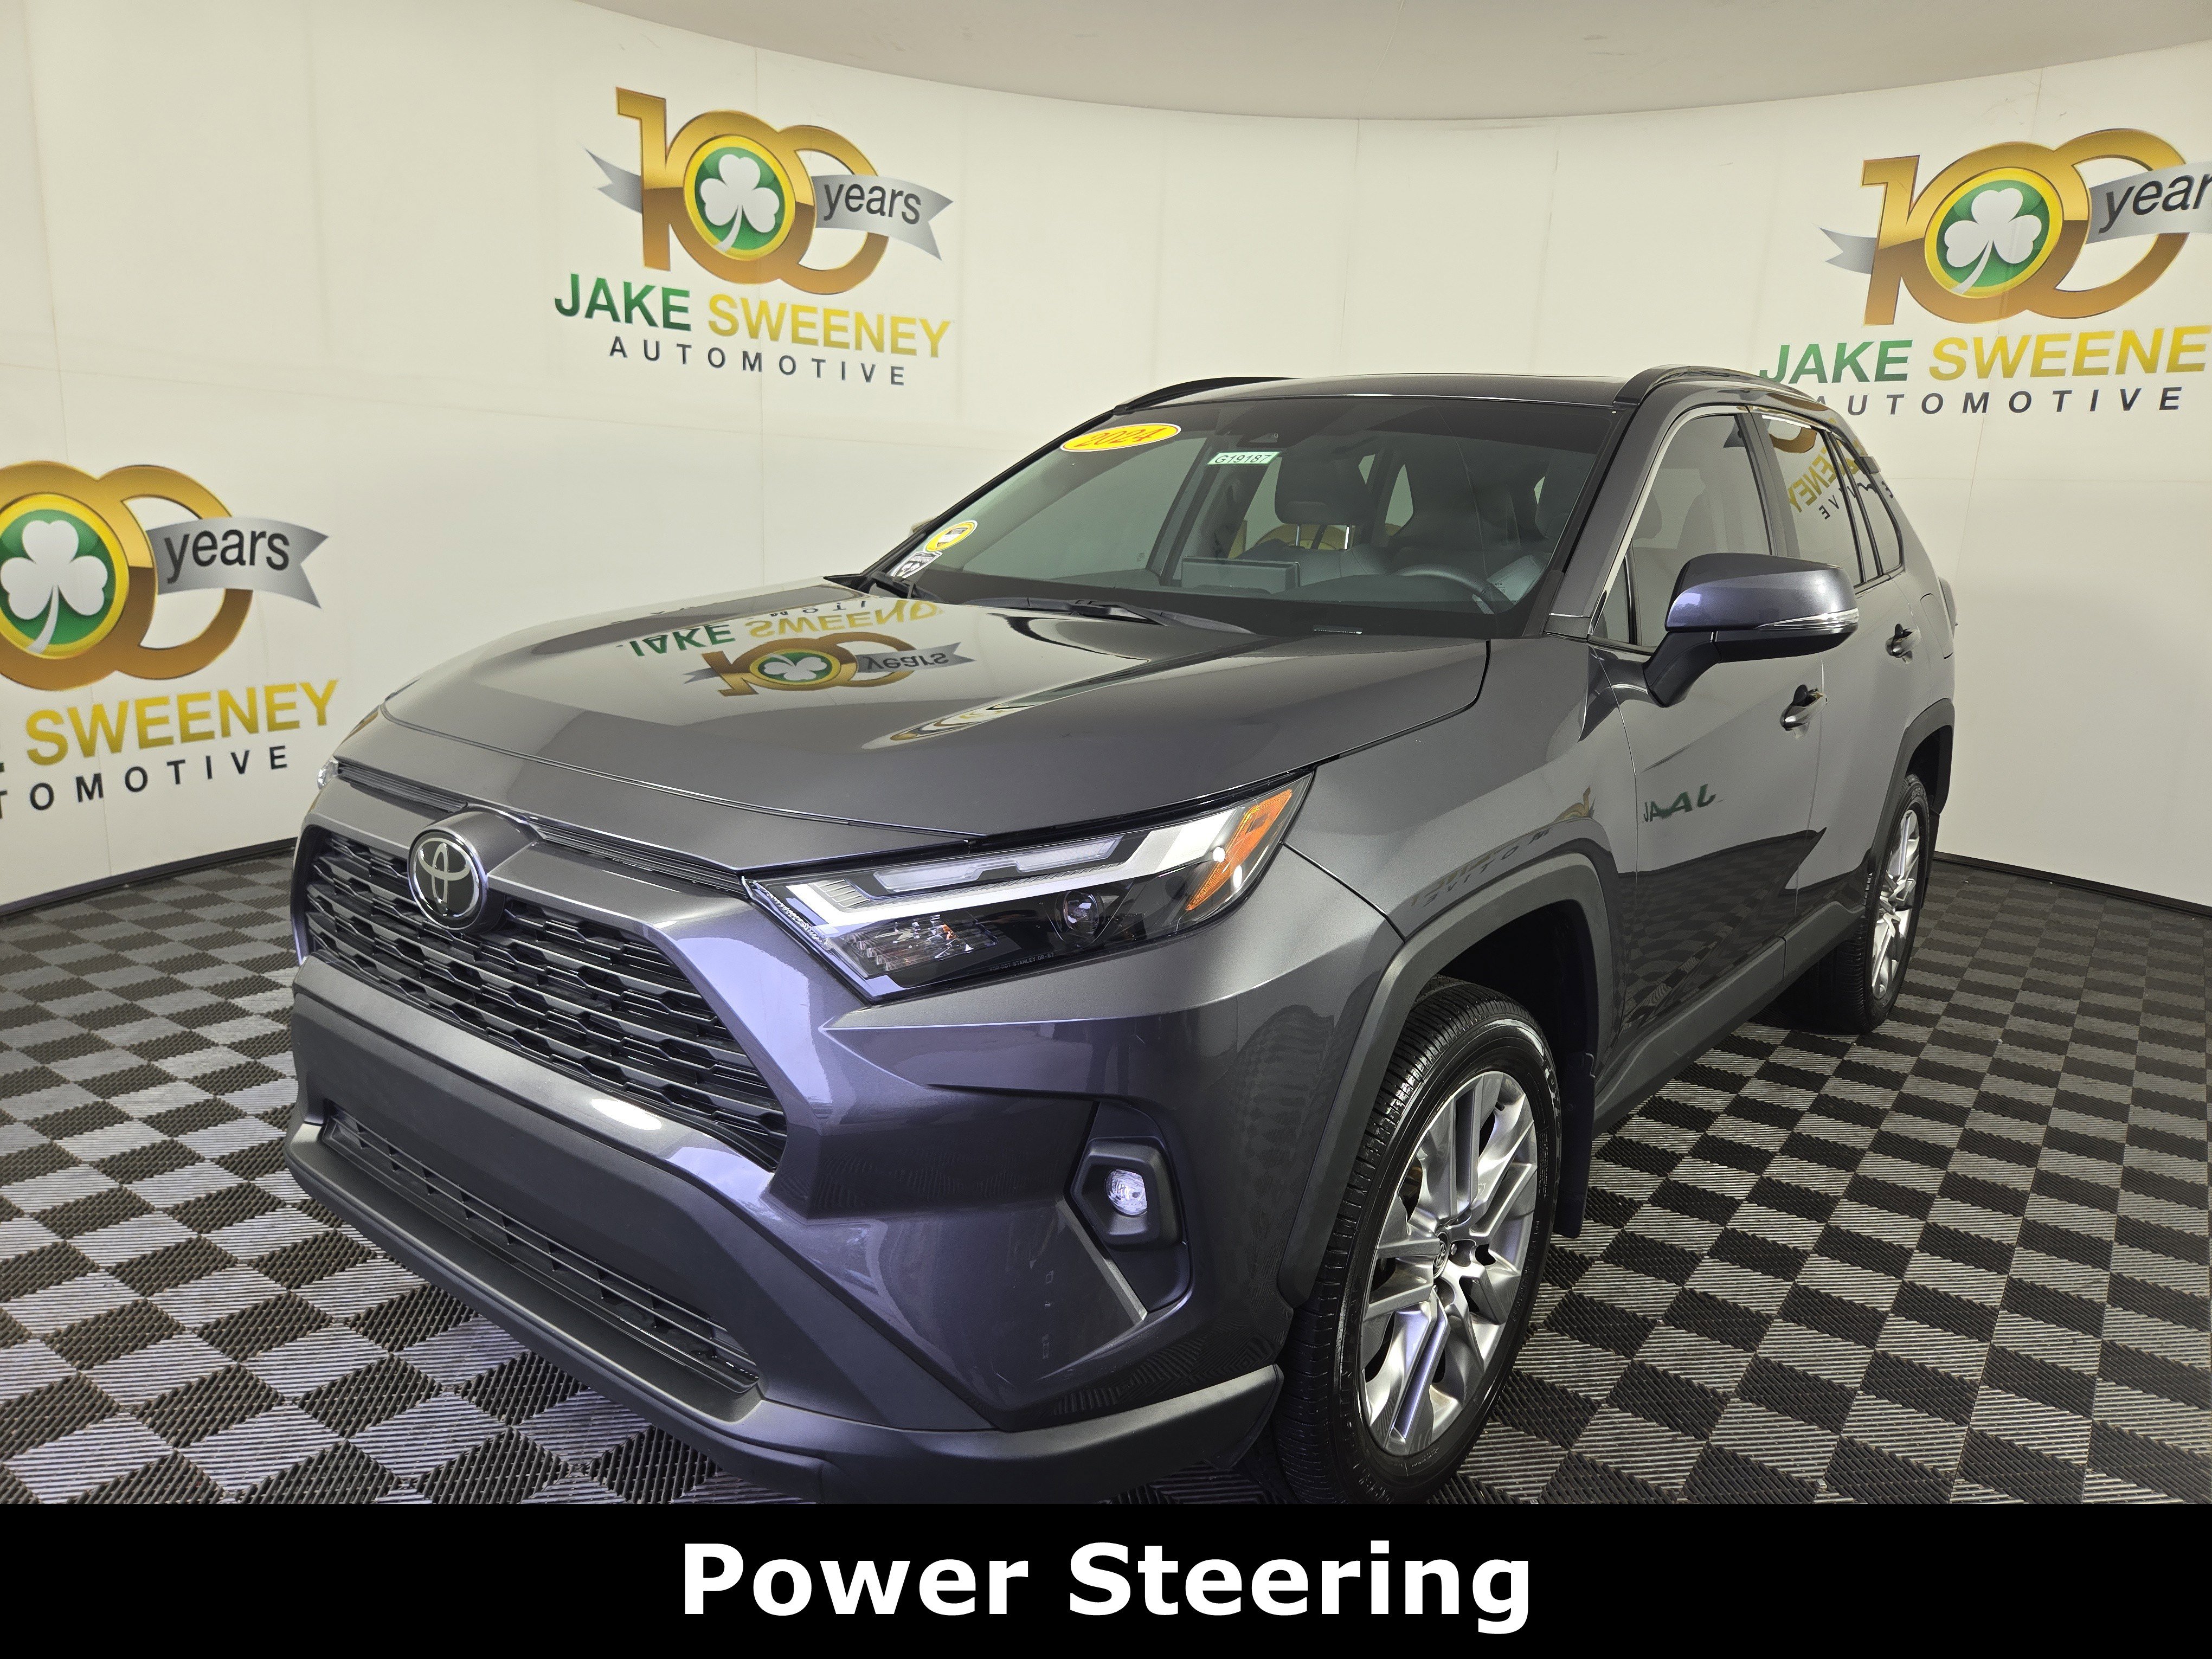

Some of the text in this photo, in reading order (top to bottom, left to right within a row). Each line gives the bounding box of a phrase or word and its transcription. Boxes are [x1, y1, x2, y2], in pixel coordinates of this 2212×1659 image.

[823, 183, 922, 224] years
[555, 273, 952, 358] JAKE SWEENEY
[609, 336, 905, 386] AUTOMOTIVE
[1759, 339, 1913, 384] JAKE
[1073, 427, 1168, 448] 2024
[1214, 454, 1272, 464] G19187
[164, 529, 290, 584] years
[25, 679, 339, 767] SWEENEY
[1013, 956, 1036, 967] STANLEY
